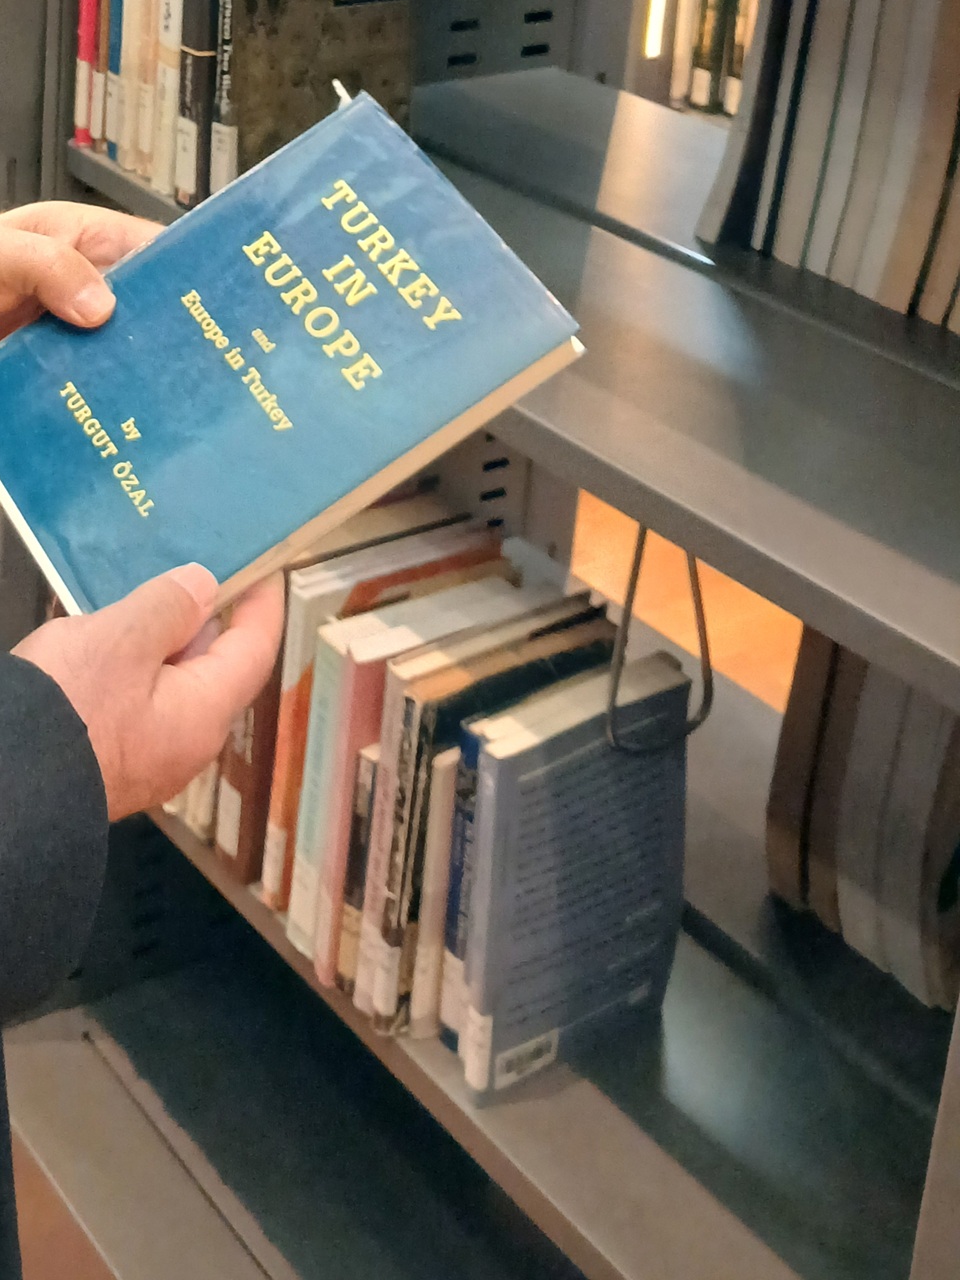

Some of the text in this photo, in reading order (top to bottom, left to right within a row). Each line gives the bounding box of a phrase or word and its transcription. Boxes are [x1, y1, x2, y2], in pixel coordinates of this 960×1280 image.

[242, 230, 384, 391] EUROPE
[320, 179, 463, 331] TURKEY
[321, 254, 379, 307] IN
[180, 289, 295, 433] Europe in Turkey
[250, 327, 277, 354] and
[58, 382, 154, 519] TURGUT ÖZAL
[120, 416, 142, 442] by
